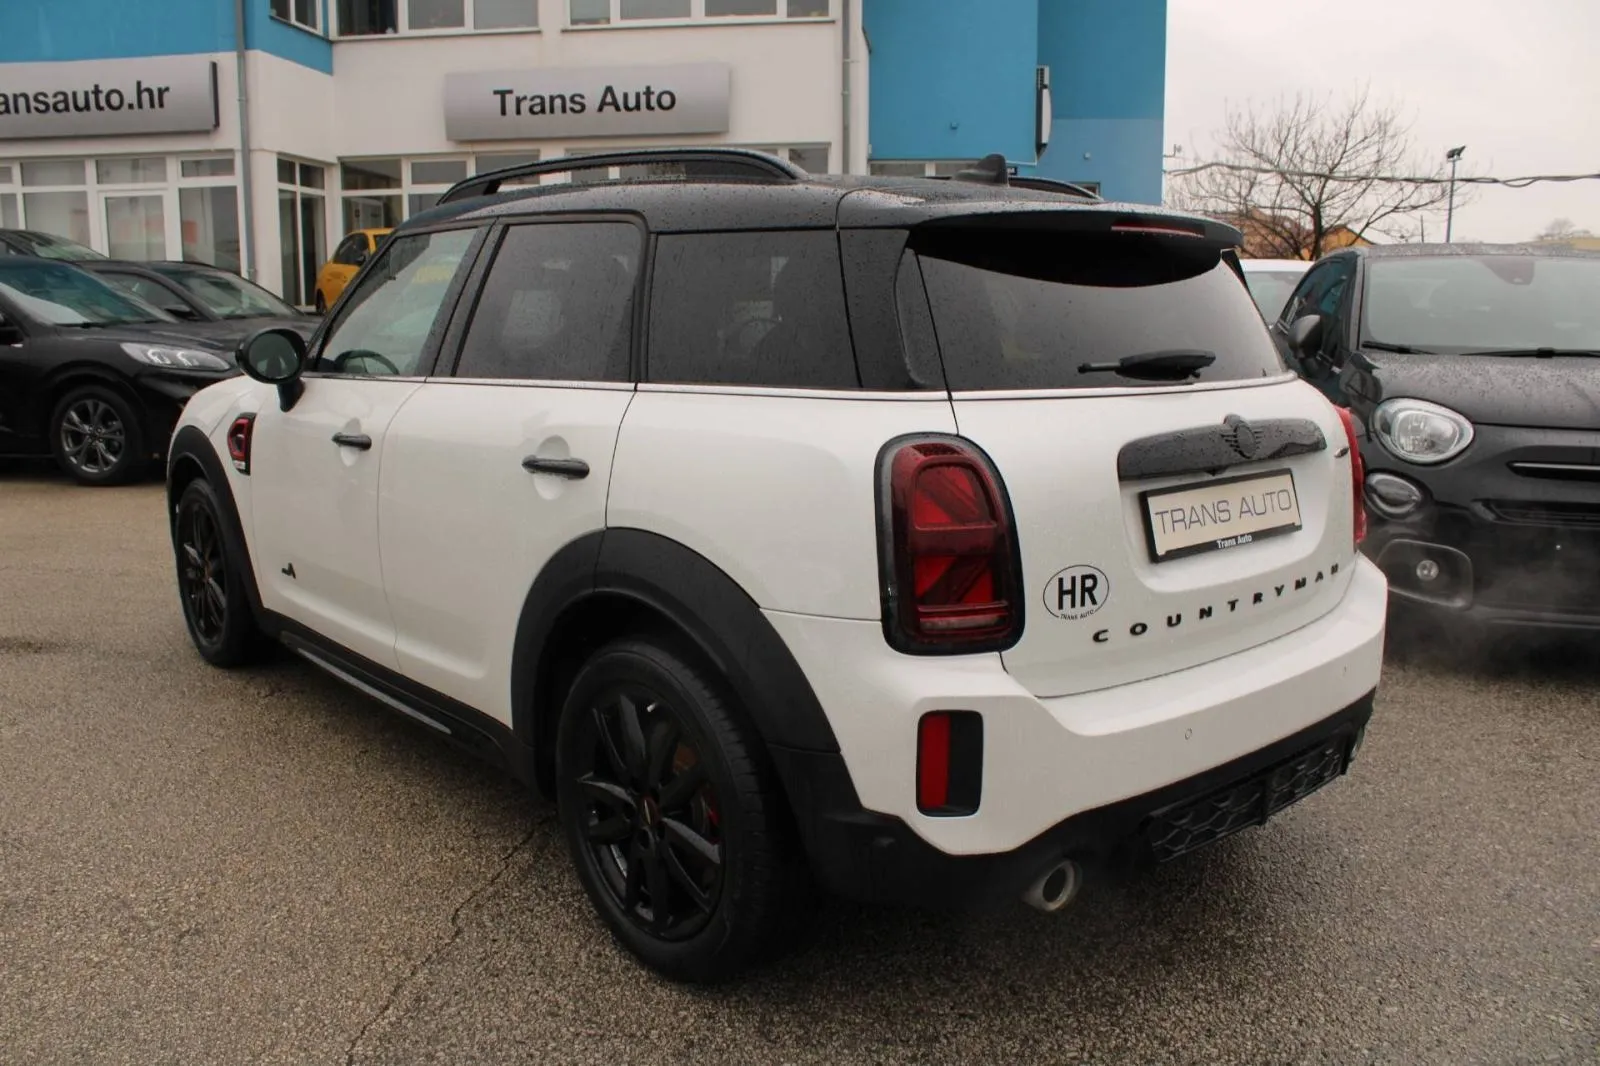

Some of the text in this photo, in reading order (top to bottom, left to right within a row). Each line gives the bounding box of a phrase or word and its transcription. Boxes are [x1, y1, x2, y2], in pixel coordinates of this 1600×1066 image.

[493, 85, 676, 116] Trans Auto
[1155, 489, 1292, 535] TRANS AUTO
[1216, 534, 1252, 549] Trans Auto
[1058, 573, 1098, 610] HR
[1092, 563, 1339, 643] COUNTRYMAN
